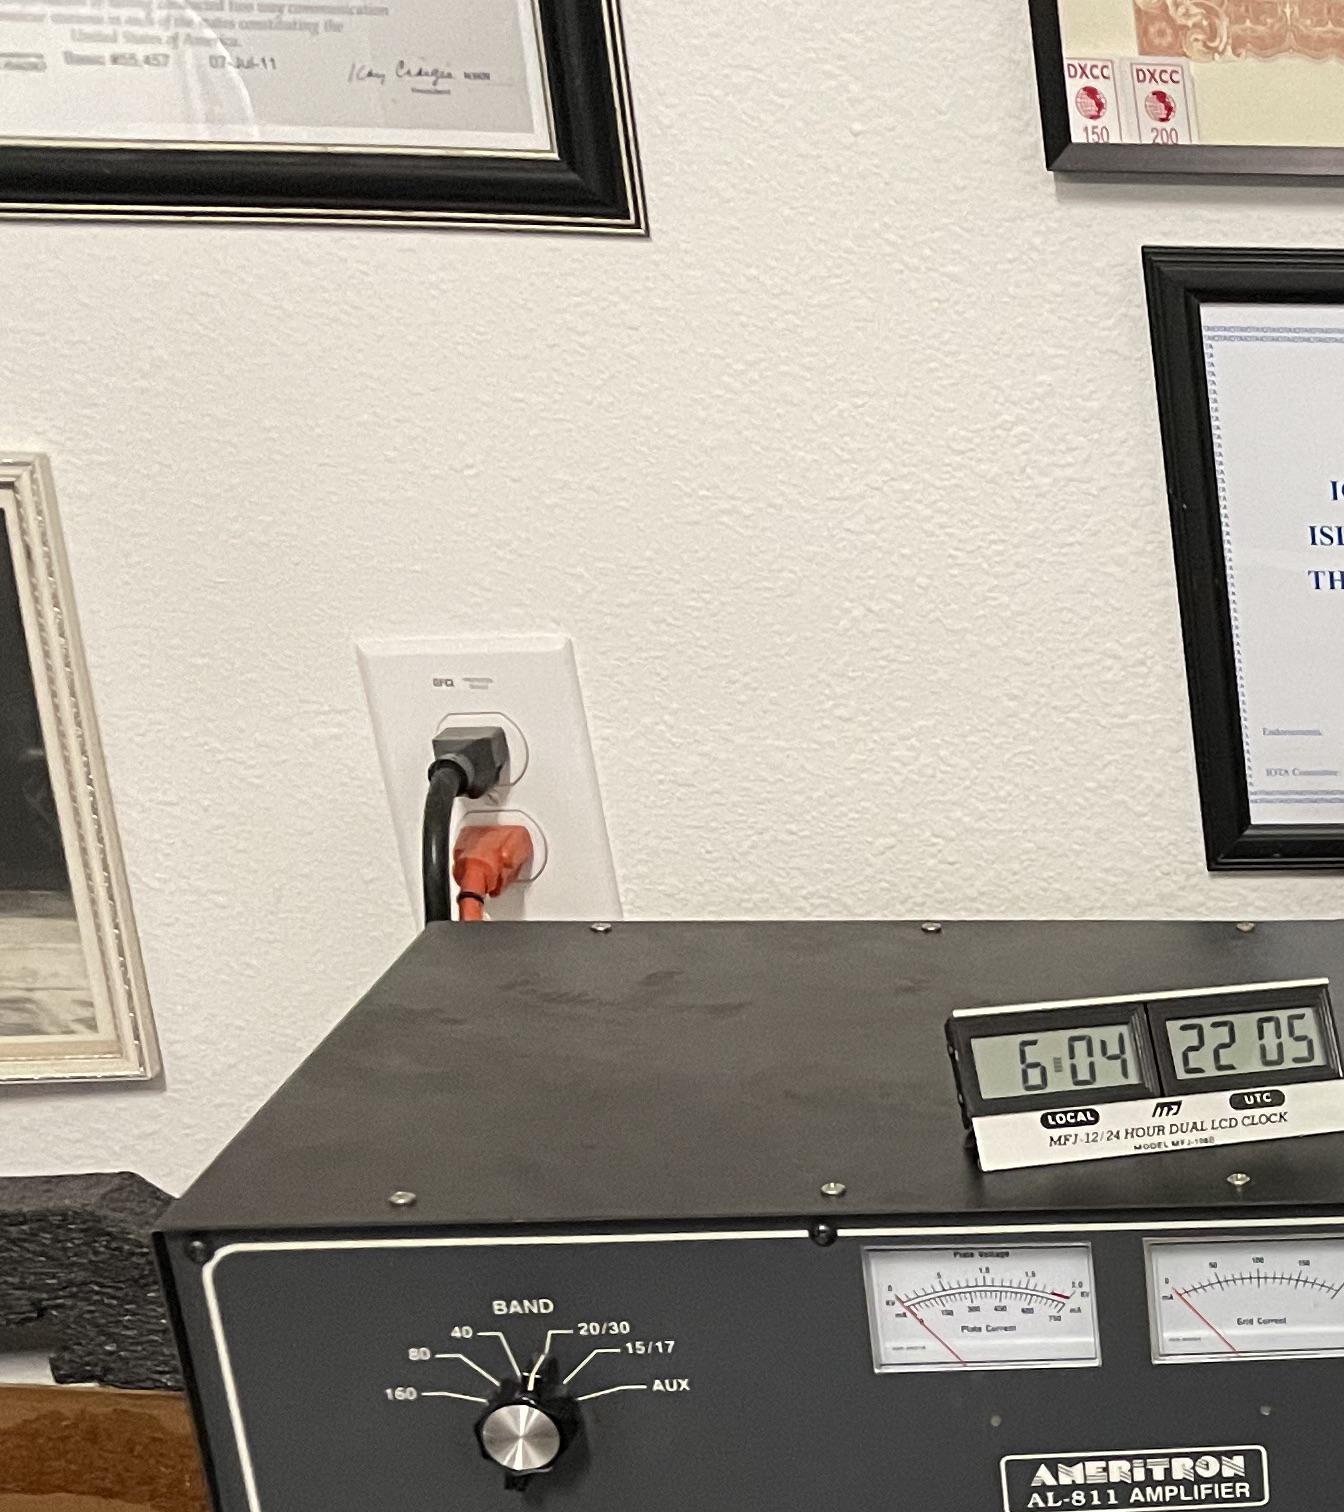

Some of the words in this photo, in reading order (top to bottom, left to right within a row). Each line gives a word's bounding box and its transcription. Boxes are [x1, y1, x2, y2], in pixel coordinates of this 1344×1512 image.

[1067, 63, 1110, 79] DXCC
[1136, 68, 1180, 84] DXCC
[1083, 126, 1110, 143] 150
[1151, 127, 1179, 144] 200
[1243, 1092, 1272, 1105] UTC
[1048, 1111, 1096, 1126] LOCAL
[1124, 1124, 1166, 1140] HOUR
[1169, 1121, 1208, 1135] DUAL
[1211, 1117, 1238, 1132] LCD
[1241, 1111, 1289, 1128] CLOCK
[492, 1298, 554, 1315] BAND
[450, 1325, 473, 1339] 40
[577, 1320, 631, 1337] 20/30
[407, 1347, 432, 1361] 80
[624, 1340, 676, 1356] 15/17
[385, 1386, 418, 1401] 160
[652, 1378, 691, 1393] AUX
[1027, 1488, 1118, 1508] AL-811
[1130, 1482, 1251, 1502] AMPLIFIER
